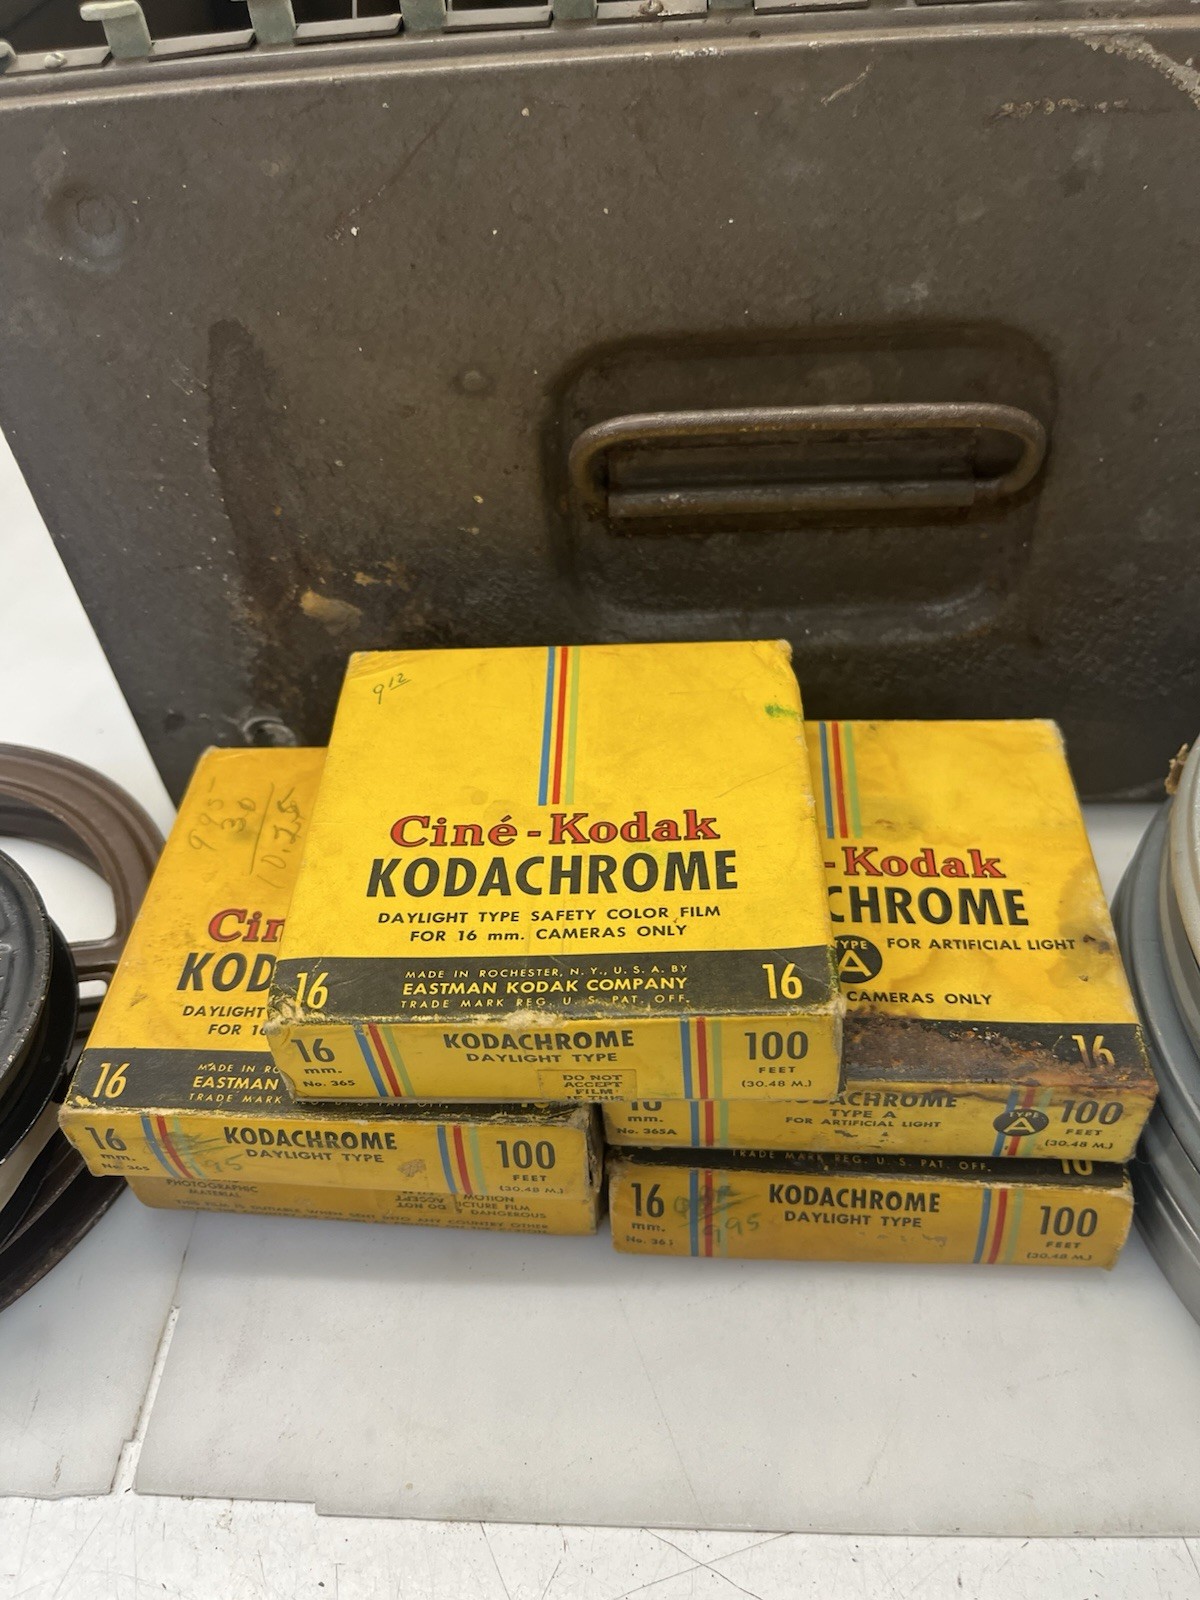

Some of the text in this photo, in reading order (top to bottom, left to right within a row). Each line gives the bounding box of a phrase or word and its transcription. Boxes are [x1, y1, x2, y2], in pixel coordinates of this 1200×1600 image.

[366, 850, 738, 898] KODACHROME
[378, 906, 721, 924] DAYLIGHT TYPE SAFETY COLOR FILM
[410, 924, 687, 942] FOR 16 mm. CAMERAS ONLY
[887, 937, 1076, 950] FOR ARTIFICIAL LIGHT
[838, 949, 872, 977] A
[405, 970, 445, 979] MADE
[453, 970, 469, 978] IN
[479, 968, 563, 978] ROCHESTER,
[671, 964, 688, 973] BY
[402, 977, 688, 996] EASTMAN KODAK COMPANY
[762, 962, 803, 999] 16
[295, 972, 329, 1009] 16
[846, 991, 992, 1005] CAMERAS ONLY
[401, 1000, 450, 1009] TRADE
[460, 998, 504, 1008] MARK
[655, 994, 690, 1004] OFF.
[182, 1005, 266, 1018] DAYLIGHT
[208, 1024, 241, 1035] FOR
[443, 1030, 635, 1050] KODACHROME
[745, 1031, 808, 1060] 100
[291, 1038, 336, 1063] 16
[466, 1053, 618, 1063] DAYLIGHT TYPE
[198, 1064, 233, 1073] MADE
[242, 1064, 255, 1073] IN
[93, 1062, 131, 1099] 16
[192, 1076, 279, 1091] EASTMAN
[331, 1079, 355, 1087] 365
[189, 1092, 233, 1102] TRADE
[242, 1094, 282, 1104] MARK
[830, 1109, 896, 1118] TYPE A
[1061, 1099, 1124, 1125] 100
[785, 1117, 813, 1125] FOR
[821, 1118, 894, 1127] ARTIFICIAL
[1003, 1117, 1036, 1133] A
[85, 1127, 127, 1151] 16
[224, 1126, 397, 1150] KODACHROME
[617, 1127, 639, 1135] No.
[245, 1148, 384, 1163] DAYLIGHT TYPE
[497, 1140, 556, 1169] 100
[166, 1178, 258, 1193] PHOTOGRAPHIC
[512, 1174, 547, 1182] FEET
[463, 1194, 514, 1203] MOTION
[631, 1183, 664, 1218] 16
[769, 1184, 940, 1213] KODACHROME
[784, 1211, 922, 1227] DAYLIGHT TYPE
[1040, 1206, 1098, 1237] 100
[1046, 1241, 1081, 1249] FEET
